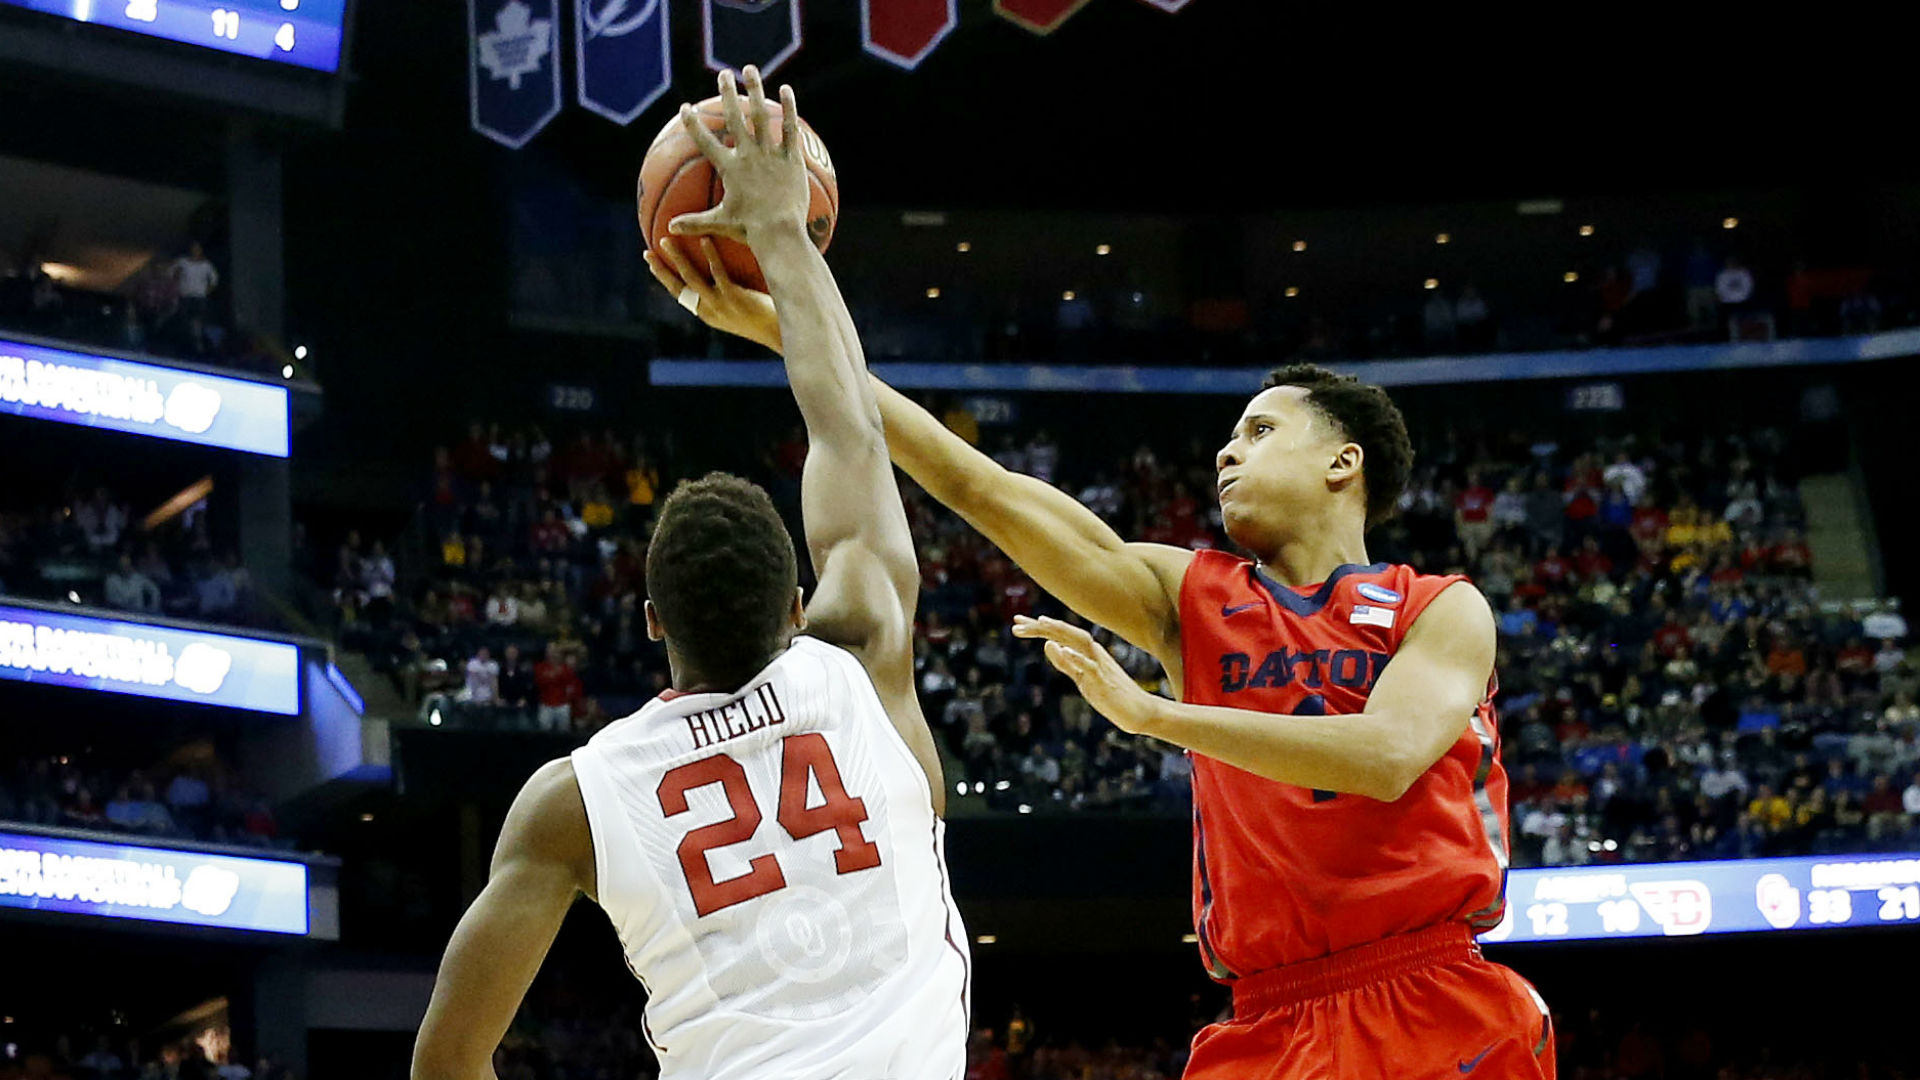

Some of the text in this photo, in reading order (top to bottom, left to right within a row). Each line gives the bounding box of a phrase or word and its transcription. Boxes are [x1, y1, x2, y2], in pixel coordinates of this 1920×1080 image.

[211, 8, 240, 40] 11
[683, 682, 785, 750] HIELD
[656, 733, 882, 919] 24
[1526, 903, 1568, 936] 12
[1877, 885, 1920, 921] 21
